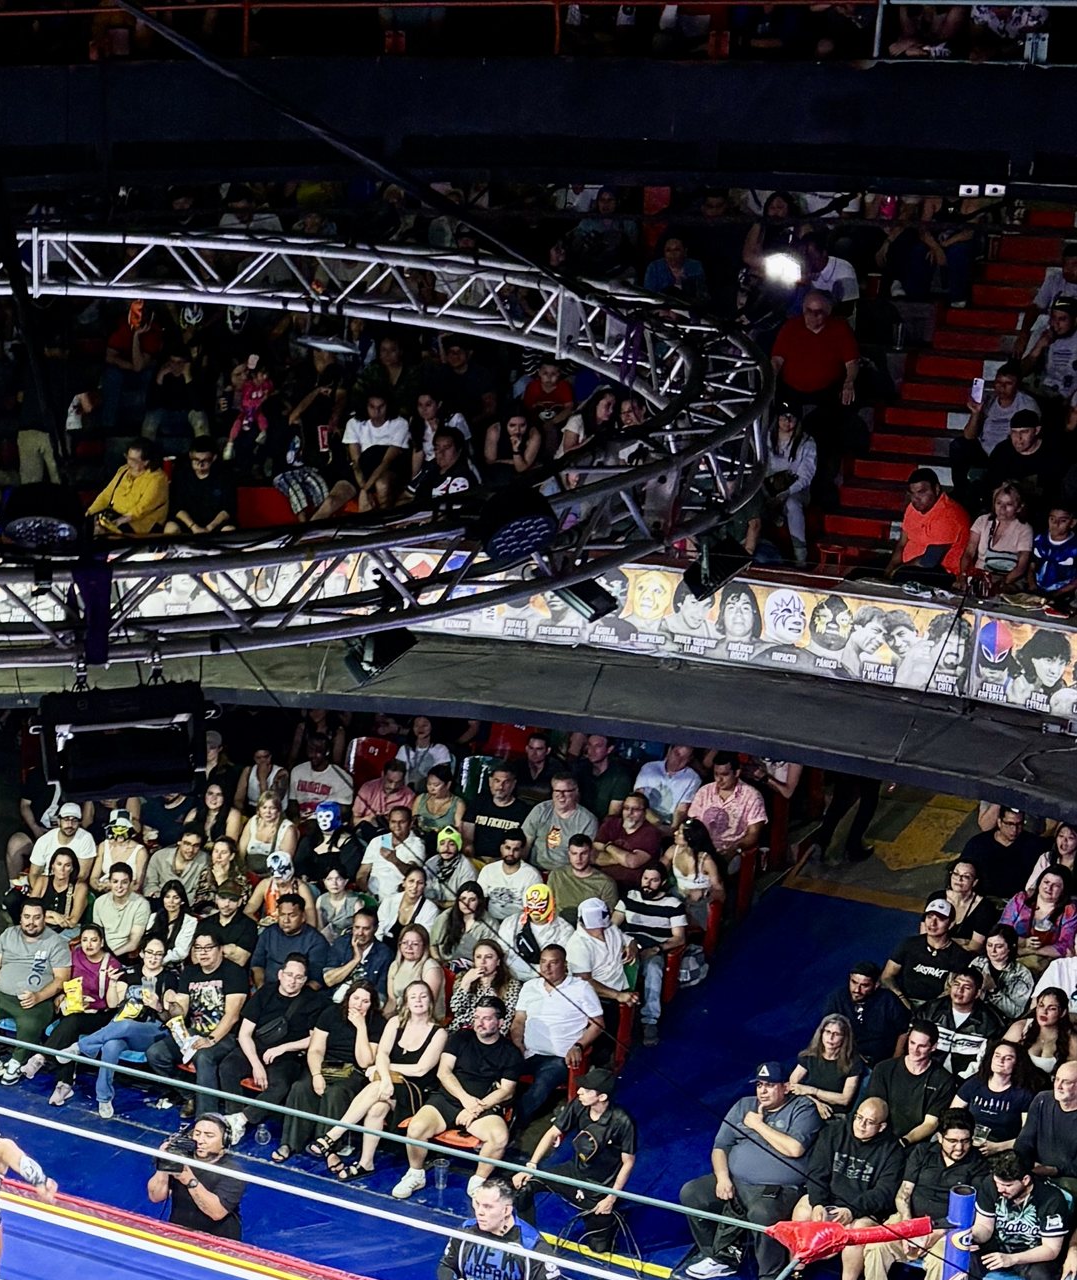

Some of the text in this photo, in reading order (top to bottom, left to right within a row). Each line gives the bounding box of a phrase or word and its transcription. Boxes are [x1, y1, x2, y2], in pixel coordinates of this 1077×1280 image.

[638, 634, 666, 645] SUPREMO
[937, 682, 953, 693] COTA
[982, 682, 1004, 695] FUERZA
[1025, 699, 1051, 713] ESTRADA
[913, 963, 949, 979] ABSTRACT
